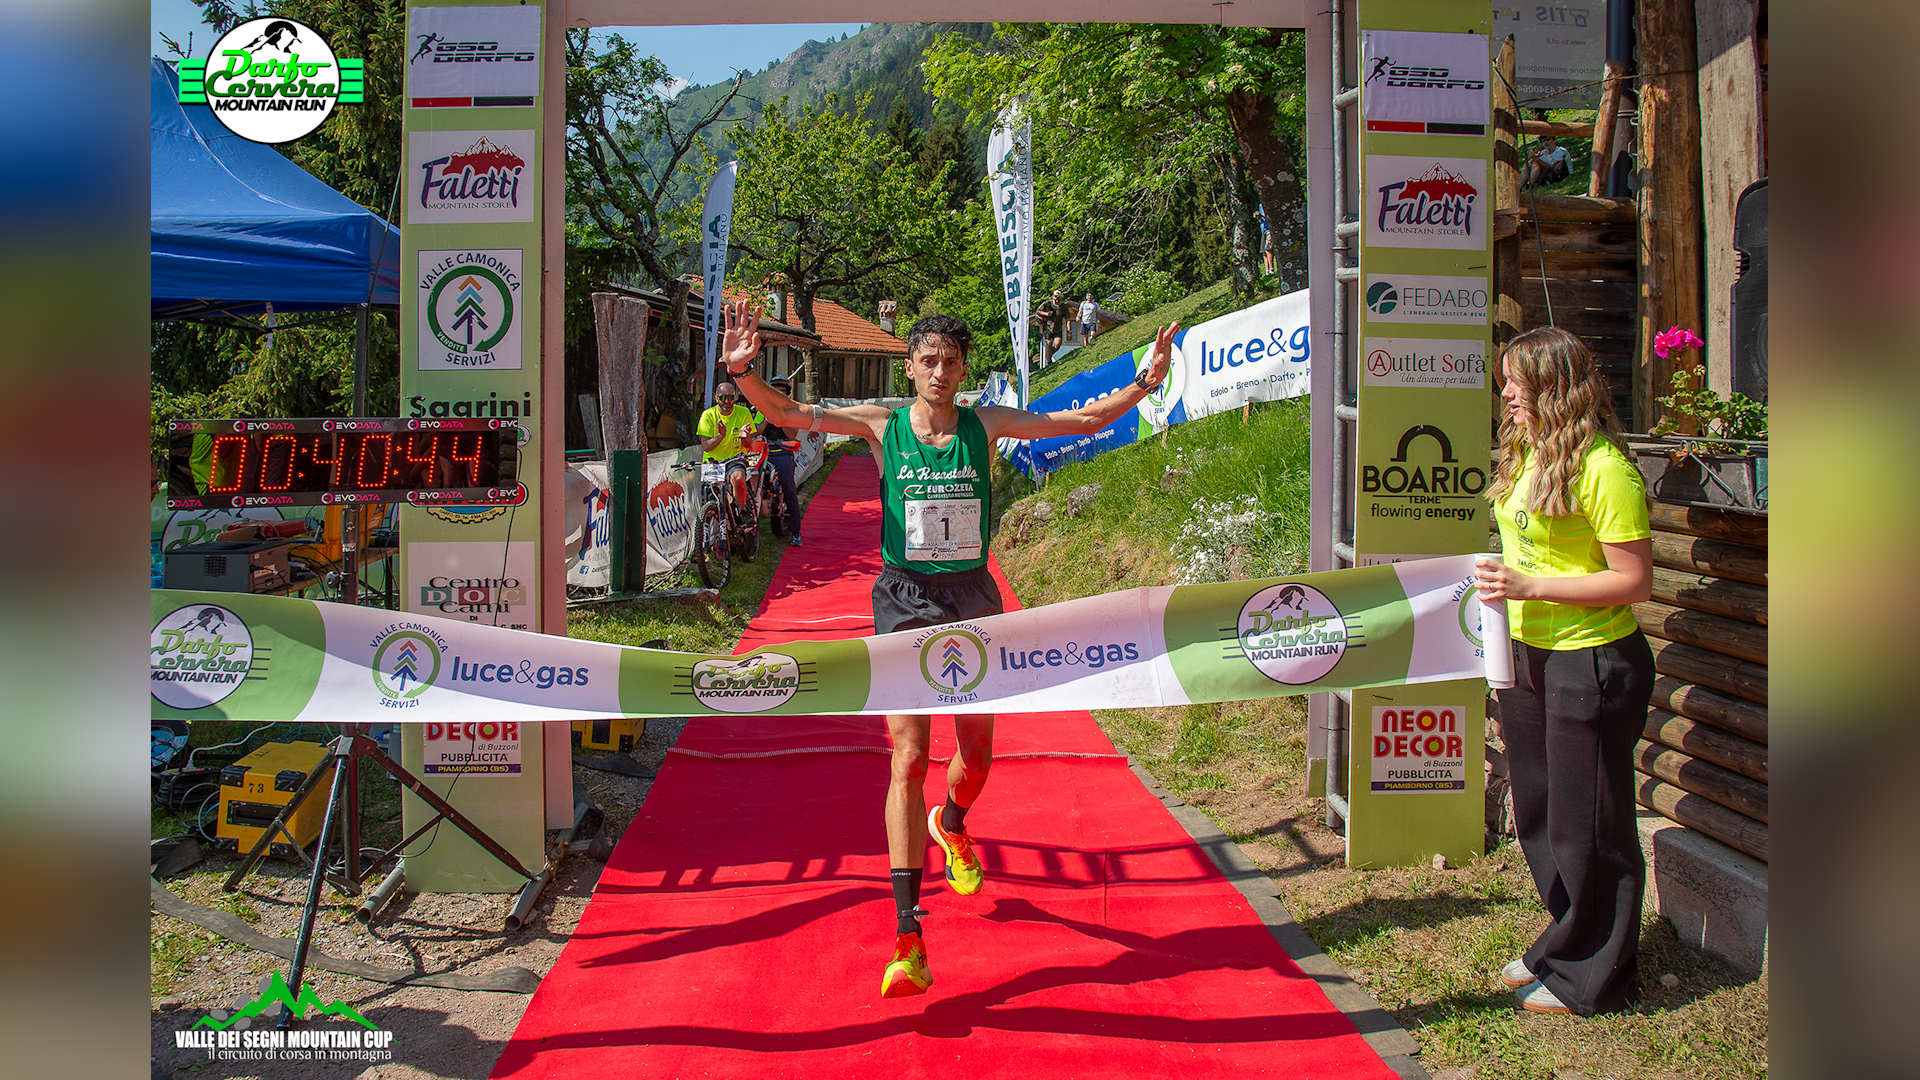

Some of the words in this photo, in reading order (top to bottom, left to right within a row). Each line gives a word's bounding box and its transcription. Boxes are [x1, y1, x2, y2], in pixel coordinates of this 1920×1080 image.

[421, 156, 522, 209] Faletti
[428, 202, 479, 210] MOUNTAIN
[1378, 181, 1475, 236] Faletti
[1438, 228, 1465, 236] STORE
[420, 257, 454, 291] VALLE
[456, 252, 521, 292] CAMONICA
[1403, 288, 1488, 308] FEDABO
[436, 331, 465, 353] VENDITE
[446, 352, 496, 366] SERVIZI
[1442, 353, 1487, 374] Sofà
[1210, 386, 1228, 398] Edolo
[1236, 378, 1260, 390] Breno
[1270, 372, 1296, 384] Darfo
[1400, 372, 1414, 382] Un
[1416, 373, 1443, 383] divano
[1444, 378, 1458, 388] per
[1459, 376, 1477, 384] tutti
[410, 391, 530, 418] Sagrini
[247, 422, 295, 430] EVODATA
[335, 422, 382, 430] EVODATA
[420, 420, 464, 428] EVODATA
[896, 465, 914, 480] La
[1363, 465, 1486, 495] BOARIO
[927, 484, 974, 493] EUROZETA
[246, 496, 294, 506] EVODATA
[334, 494, 380, 502] EVODATA
[1408, 496, 1441, 504] TERME
[1371, 503, 1422, 520] flowing
[1426, 508, 1476, 520] energy
[940, 518, 950, 540] 1
[429, 576, 520, 588] Centro
[1452, 576, 1472, 602] VALLE
[438, 600, 510, 613] Carni
[1248, 609, 1336, 634] Darfo
[160, 629, 248, 660] Darfo
[370, 623, 398, 650] VALLE
[398, 622, 448, 653] CAMONICA
[912, 628, 938, 650] VALLE
[940, 624, 992, 646] CAMONICA
[1241, 628, 1347, 650] Cervera
[1000, 641, 1139, 671] luce&gas
[1252, 646, 1312, 660] MOUNTAIN
[1314, 644, 1338, 656] RUN
[211, 673, 238, 684] RUN
[451, 656, 589, 690] luce&gas
[693, 671, 798, 690] Cervera
[699, 689, 762, 698] MOUNTAIN
[938, 692, 978, 703] SERVIZI
[379, 698, 420, 709] SERVIZI
[1382, 709, 1456, 732] NEON
[426, 722, 518, 741] DECOR
[1374, 735, 1463, 758] DECOR
[248, 783, 264, 794] 73
